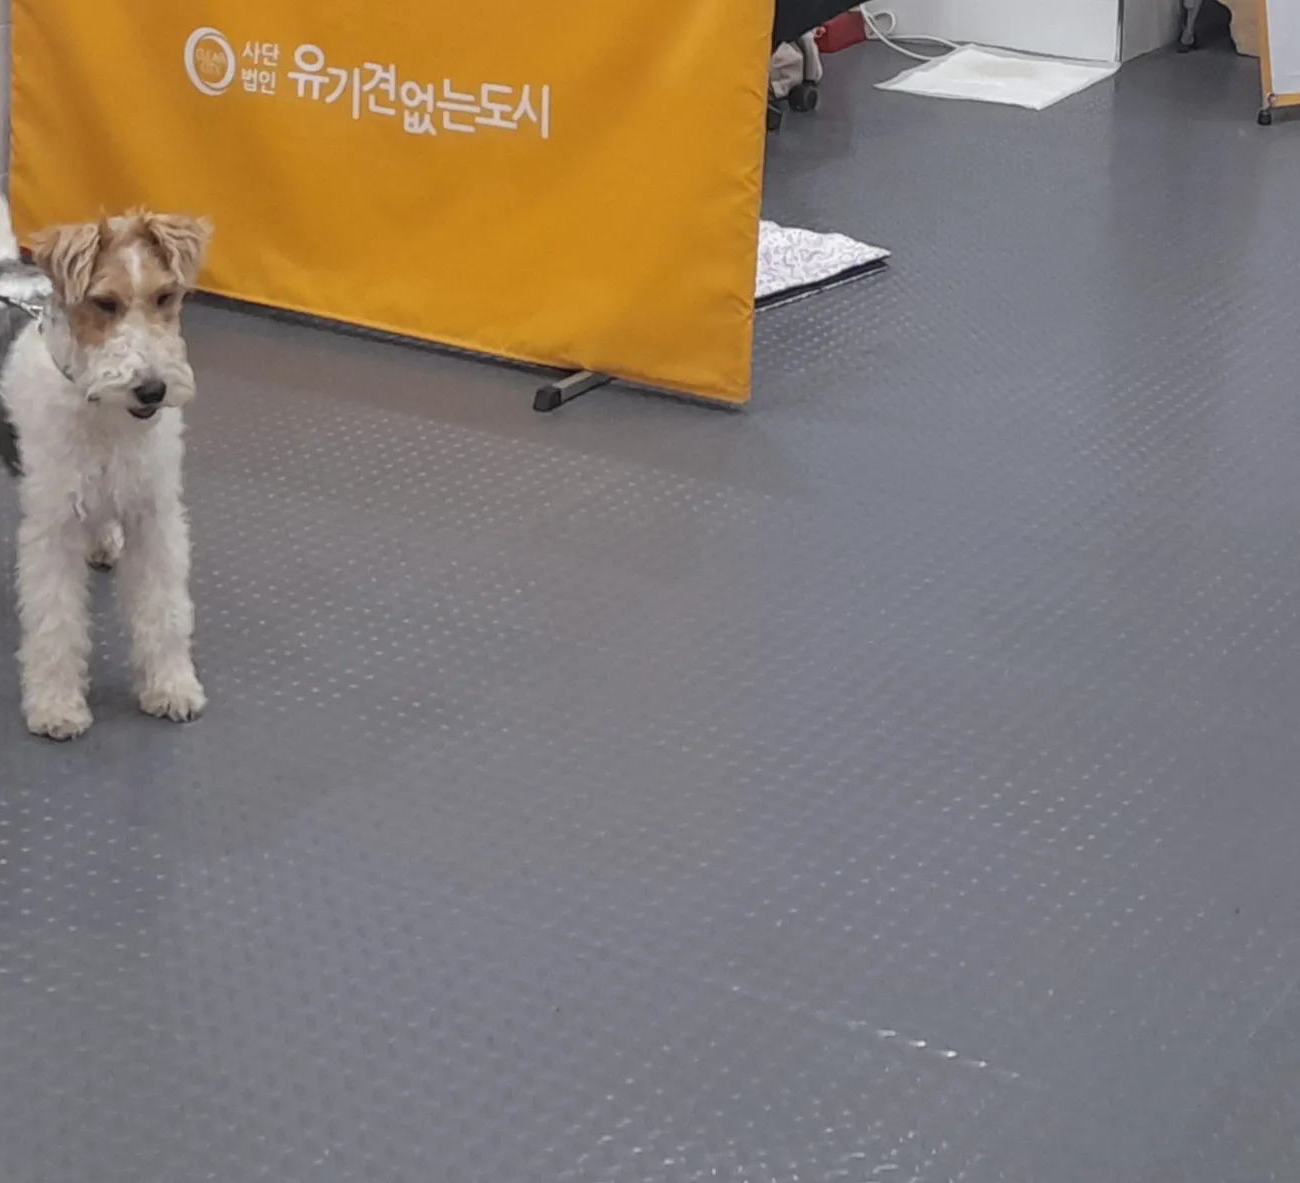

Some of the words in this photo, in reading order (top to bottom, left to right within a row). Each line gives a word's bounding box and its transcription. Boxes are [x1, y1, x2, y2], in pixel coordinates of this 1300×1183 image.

[242, 40, 279, 66] 사단
[241, 68, 276, 95] 법인
[287, 44, 550, 139] 유기견없는도시
